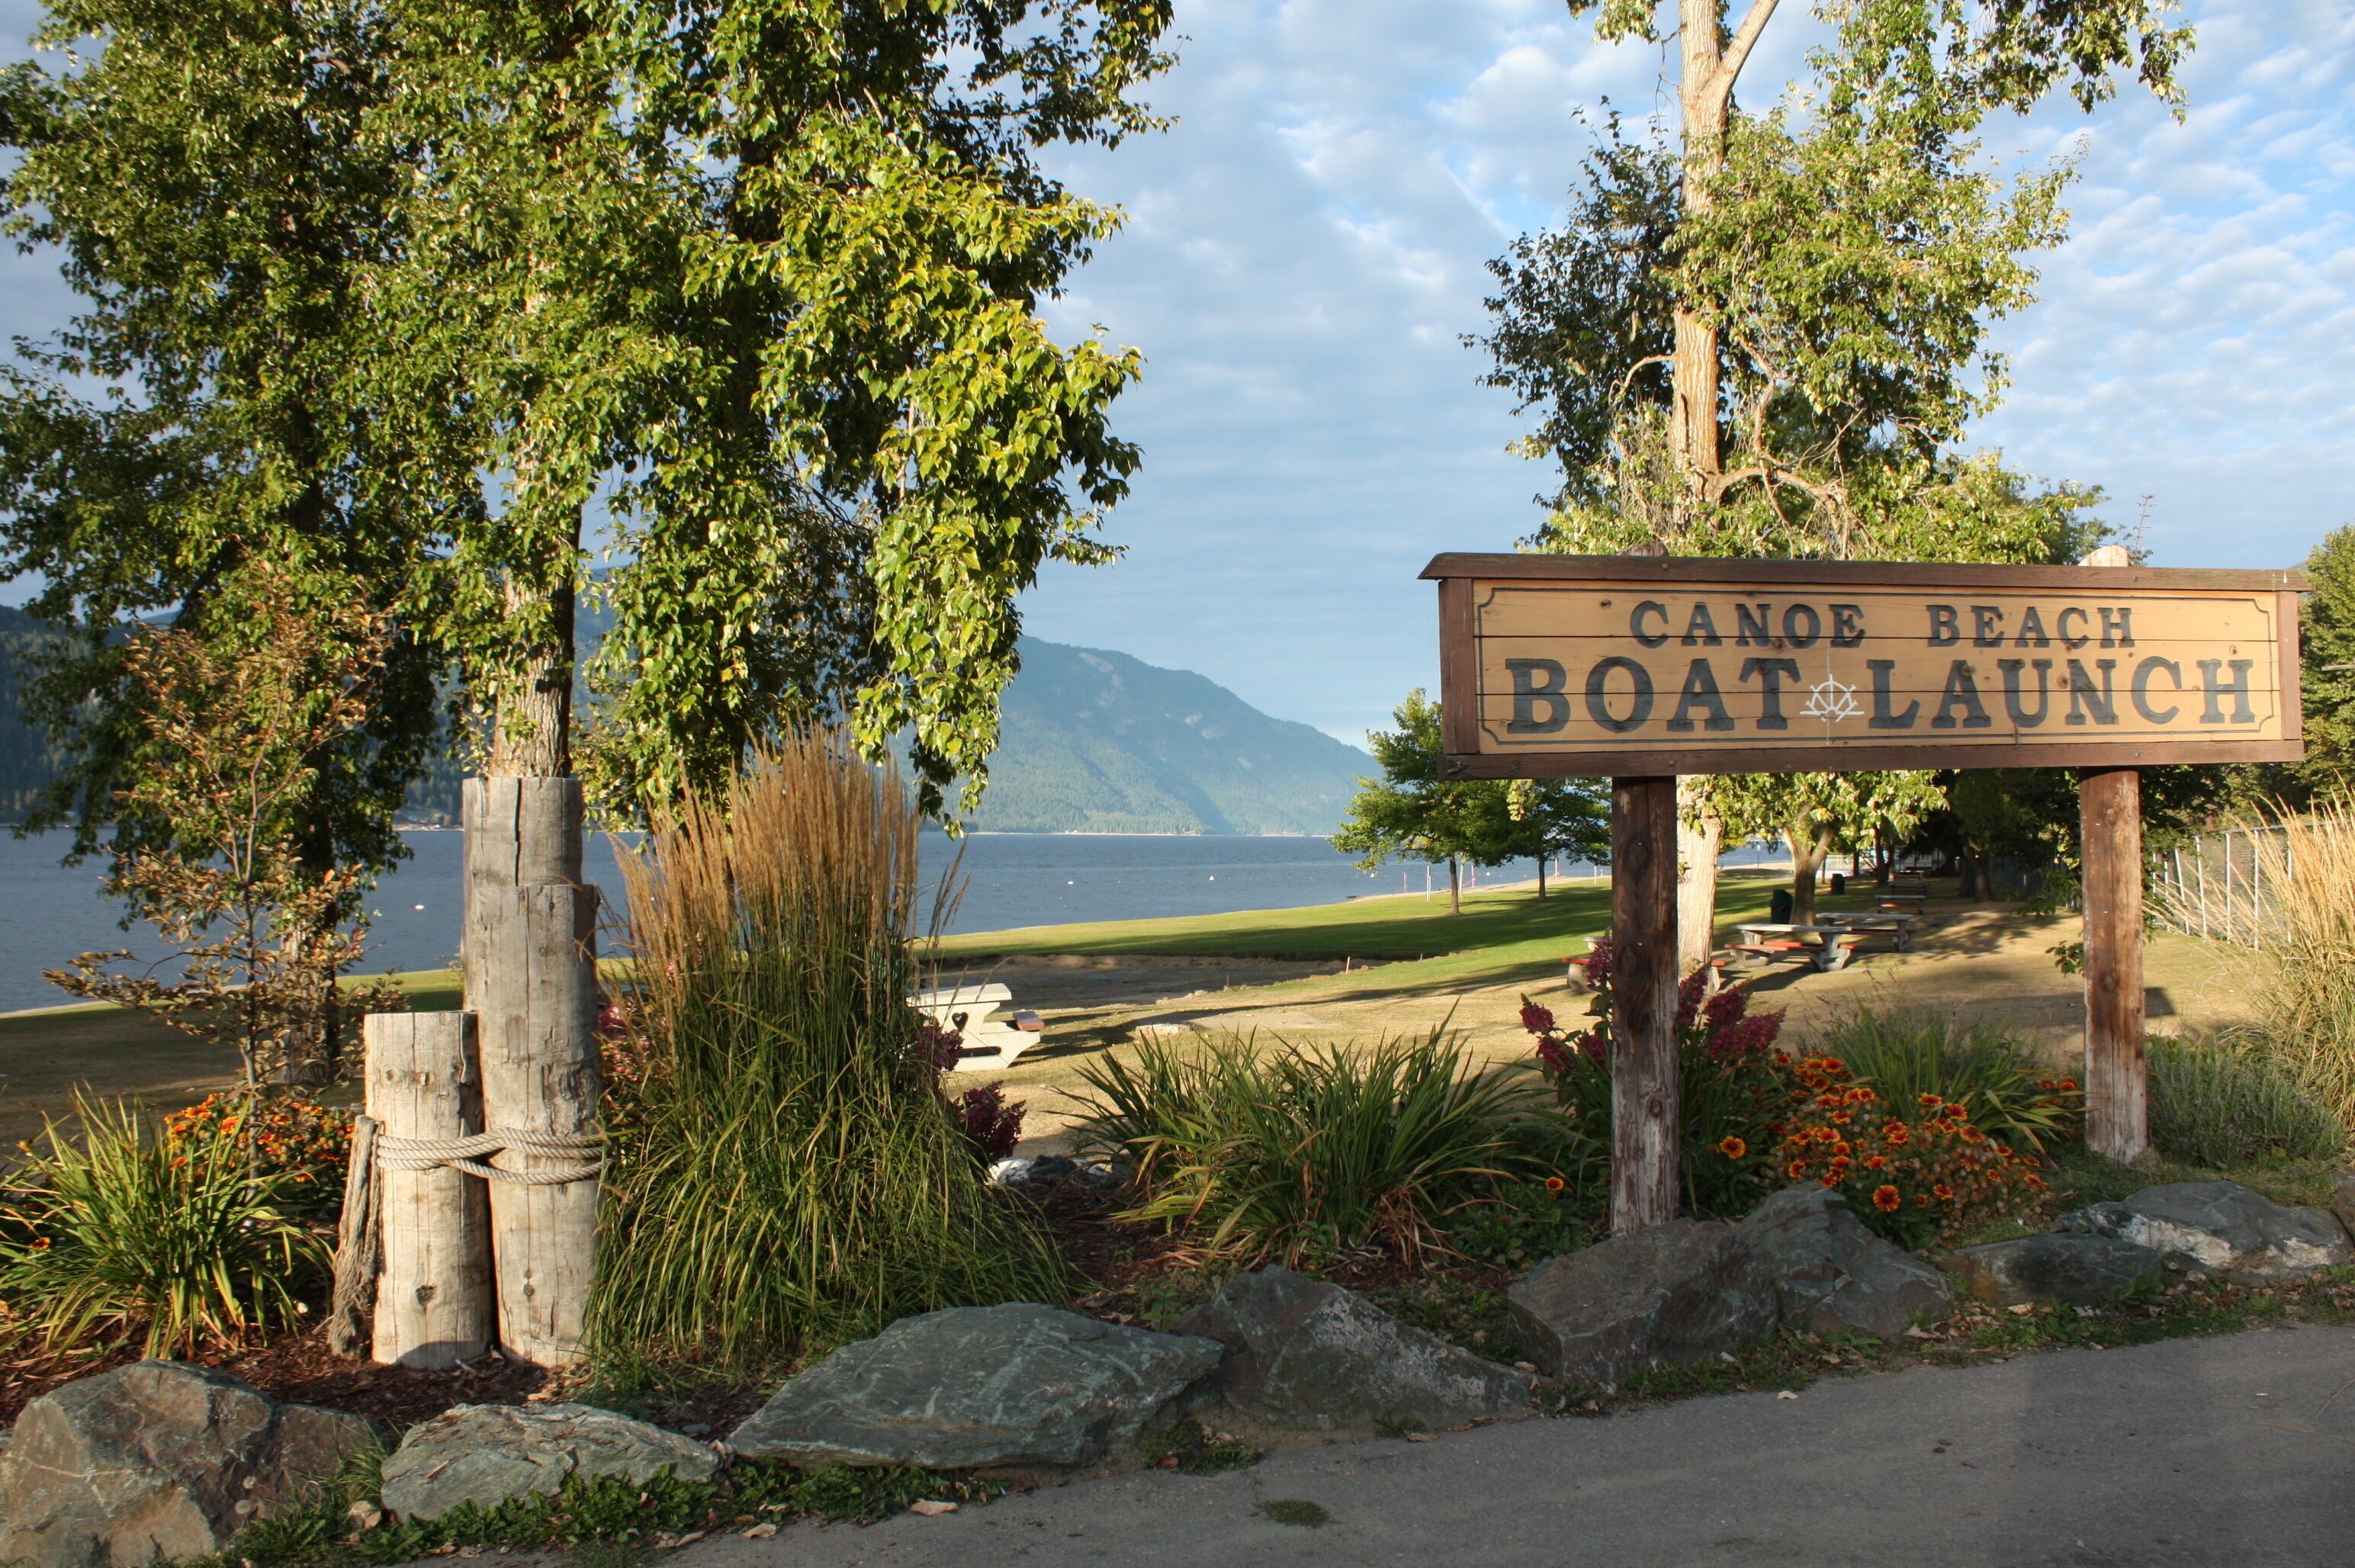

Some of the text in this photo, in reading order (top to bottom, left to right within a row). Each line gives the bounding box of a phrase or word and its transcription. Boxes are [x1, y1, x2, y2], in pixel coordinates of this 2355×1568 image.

[1631, 600, 2135, 649] CANOE BEACH
[1505, 656, 2254, 734] BOAT LAUNCH
